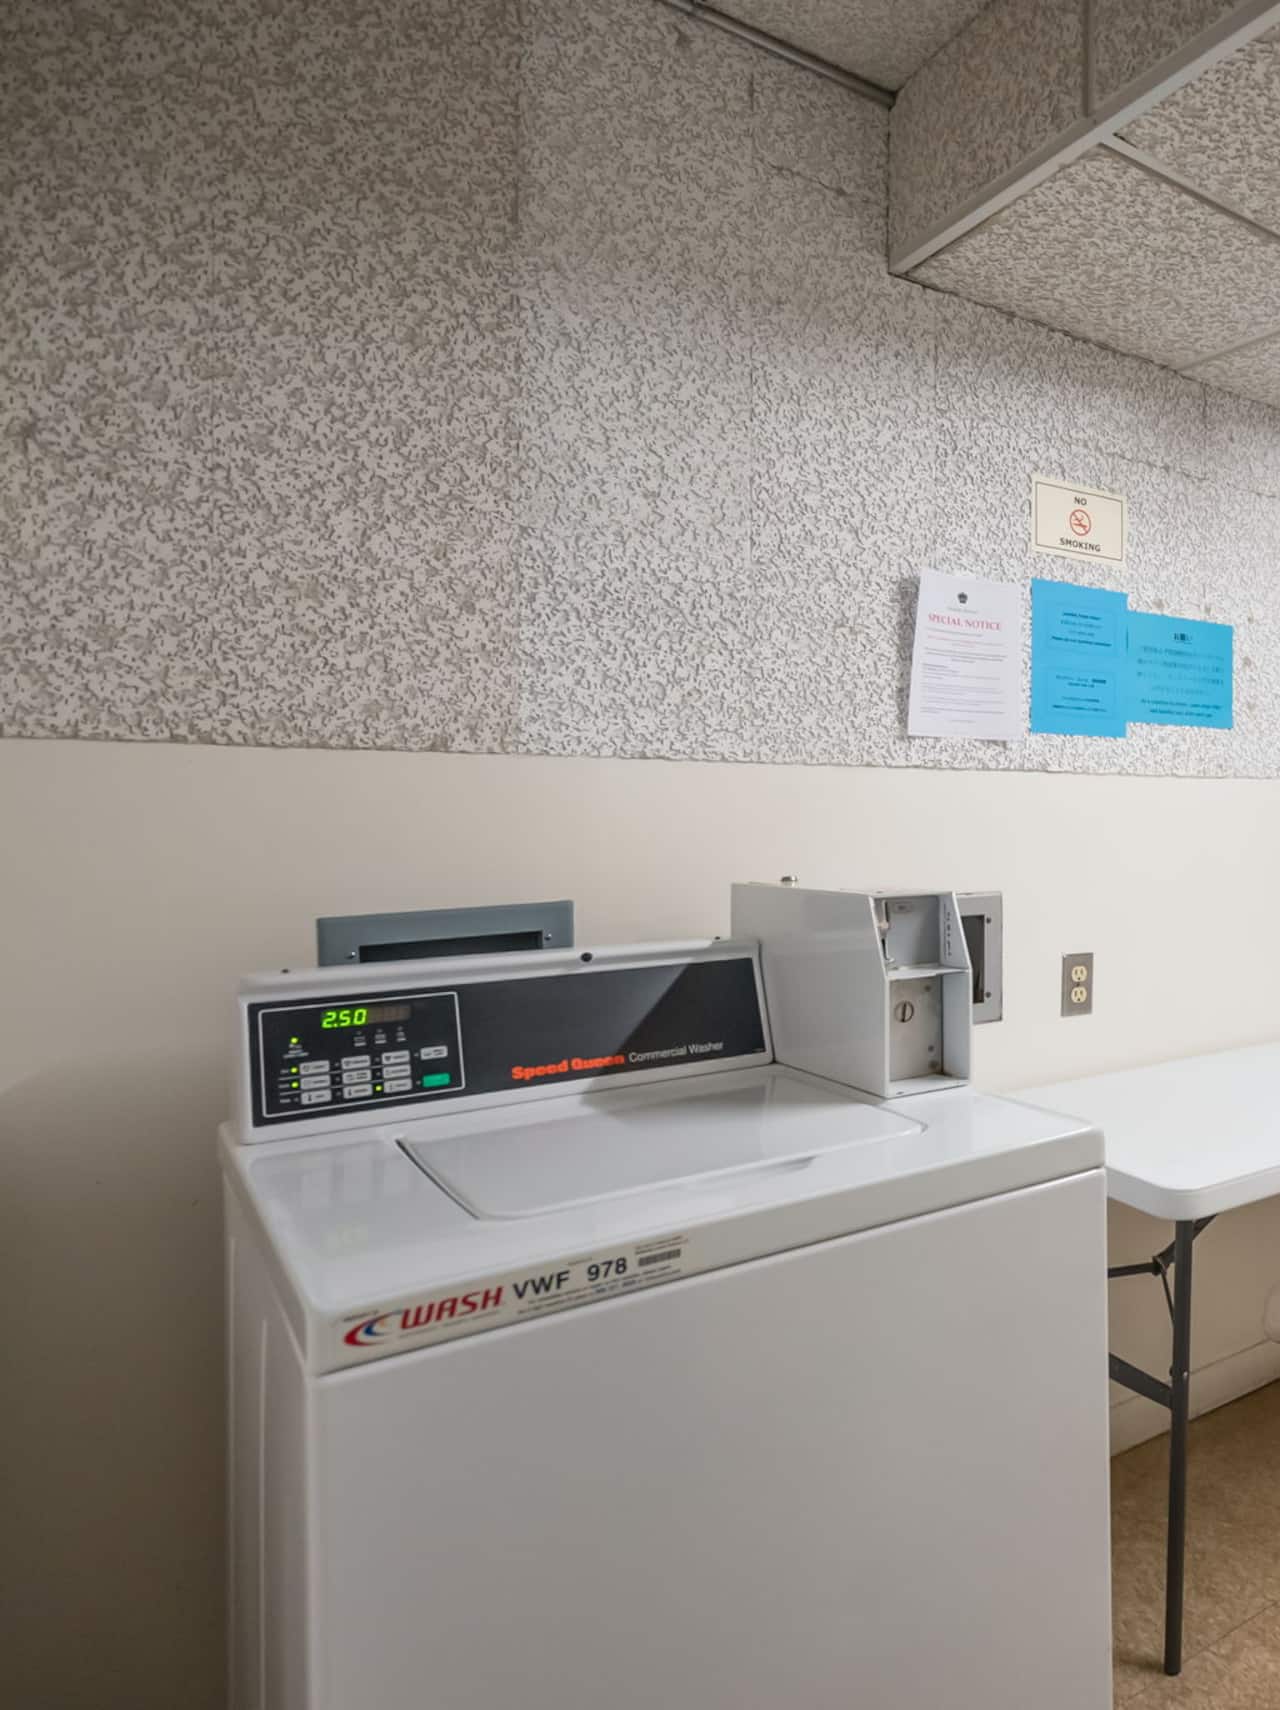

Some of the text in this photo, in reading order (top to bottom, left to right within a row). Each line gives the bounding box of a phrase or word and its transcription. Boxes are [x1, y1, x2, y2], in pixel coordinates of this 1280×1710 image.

[1073, 496, 1088, 506] NO
[1059, 536, 1102, 552] SMOKING
[928, 613, 1001, 631] SPECIAL NOTICE
[321, 1008, 368, 1028] 2.50
[511, 1041, 724, 1080] Speed Queen Commercial Washer
[400, 1285, 504, 1330] WASH
[512, 1270, 570, 1299] VWF
[587, 1257, 627, 1282] 978
